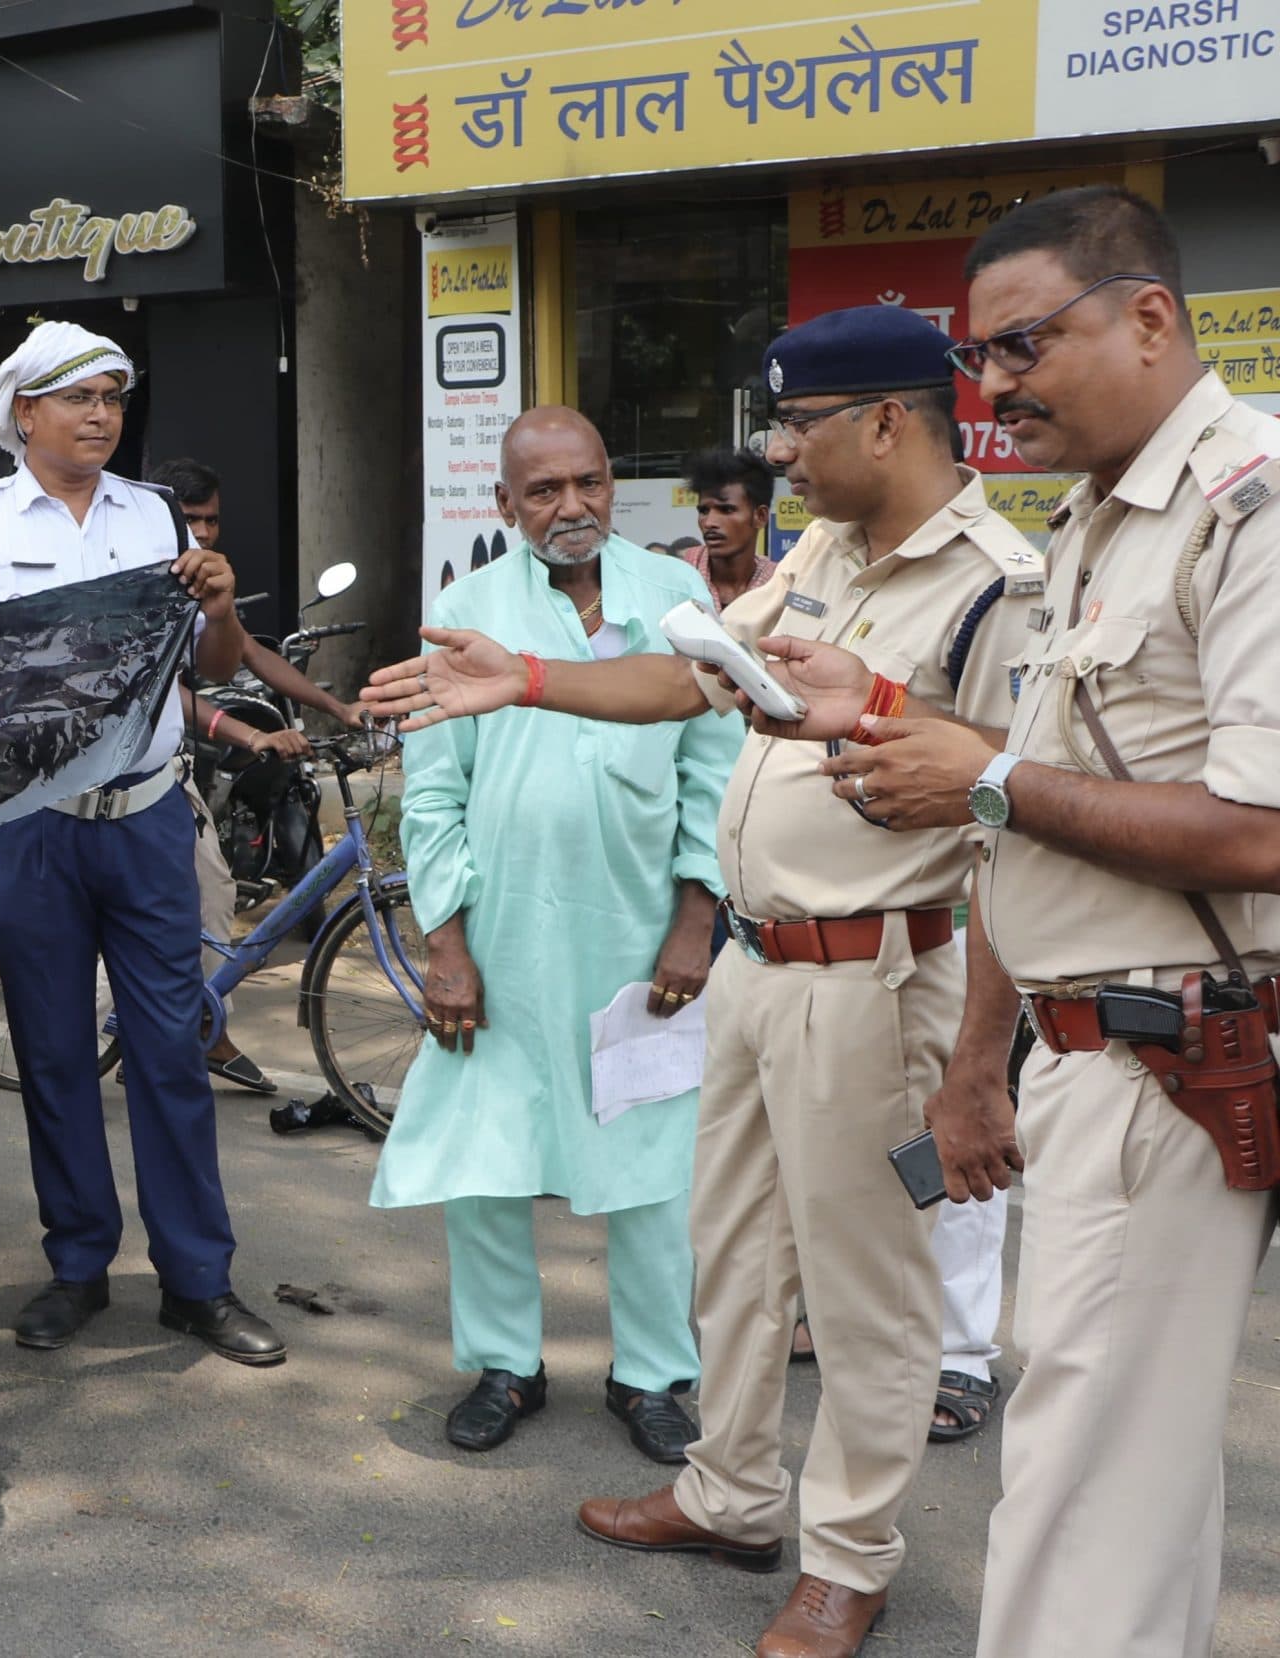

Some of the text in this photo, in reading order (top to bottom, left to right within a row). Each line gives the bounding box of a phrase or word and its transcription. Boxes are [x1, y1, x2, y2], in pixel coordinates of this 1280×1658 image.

[1103, 0, 1238, 37] SPARSH
[1067, 30, 1275, 78] DIAGNOSTIC
[455, 24, 979, 148] डॉ लाल पैथलैब्स
